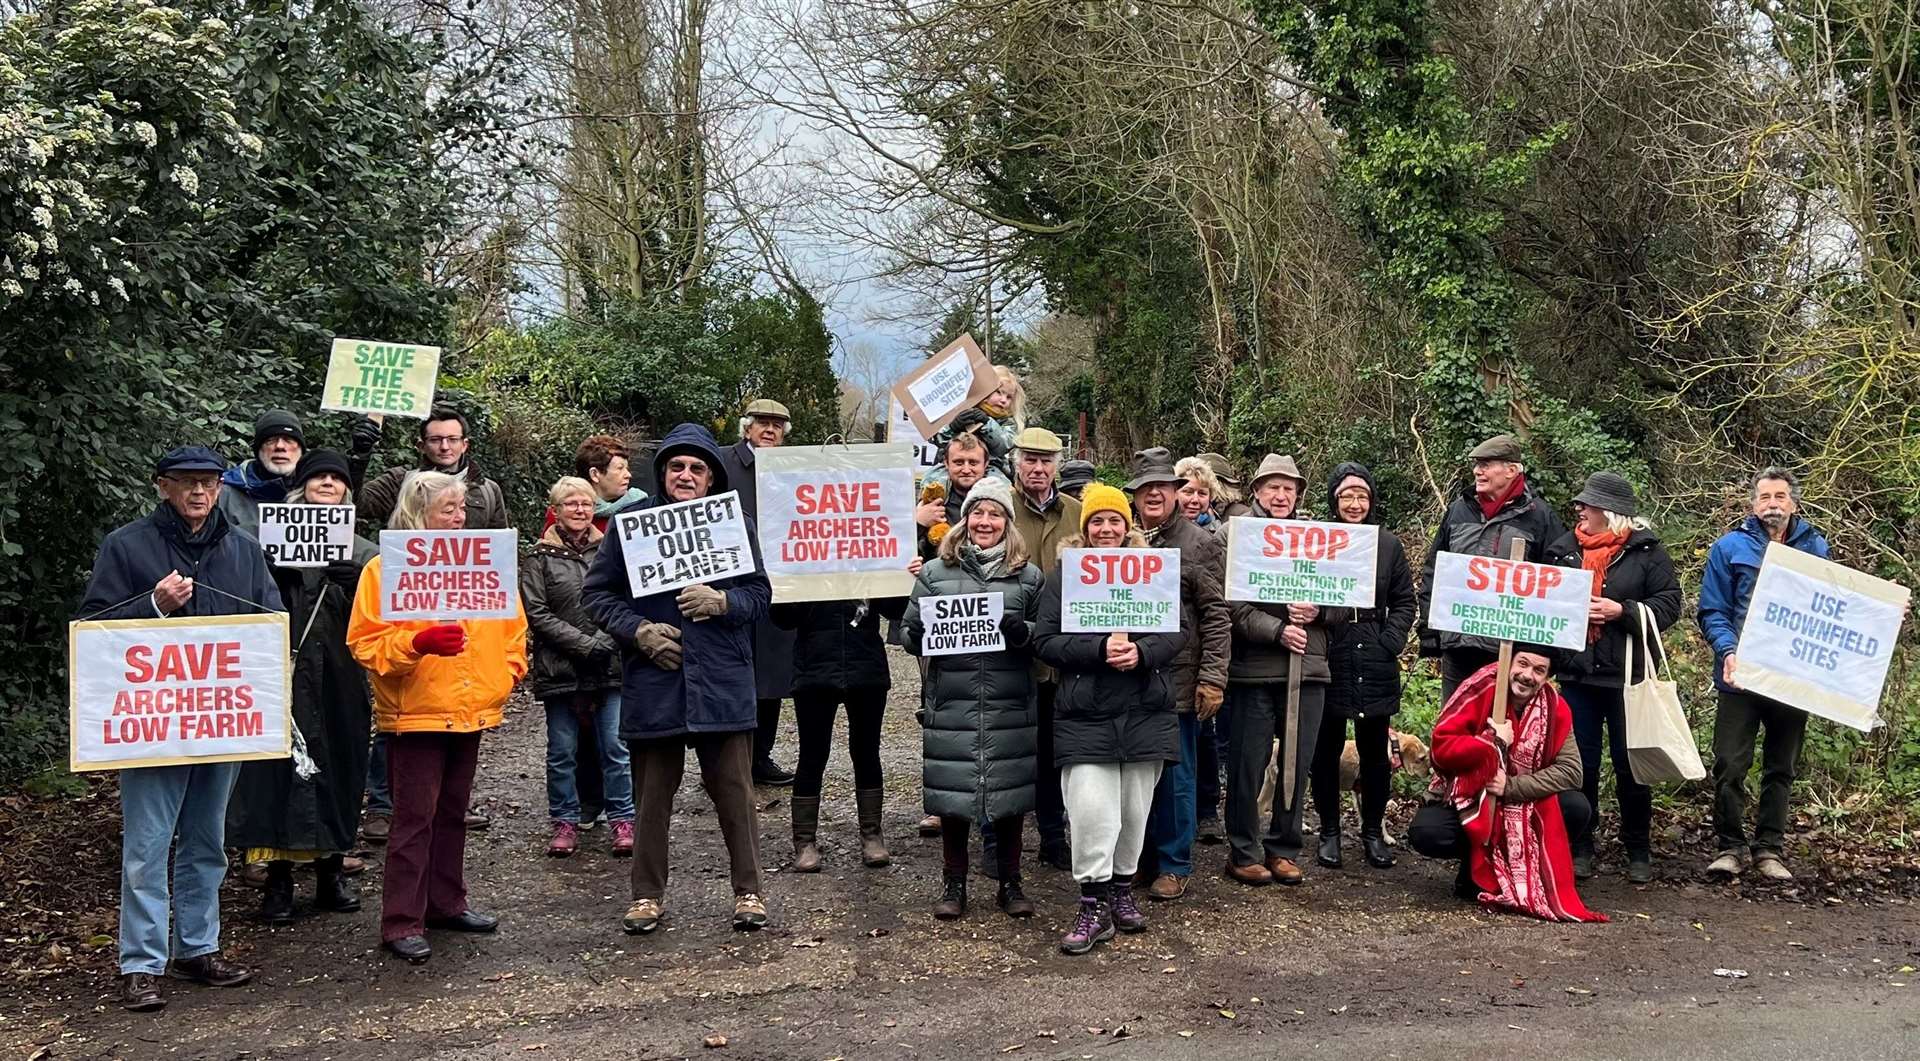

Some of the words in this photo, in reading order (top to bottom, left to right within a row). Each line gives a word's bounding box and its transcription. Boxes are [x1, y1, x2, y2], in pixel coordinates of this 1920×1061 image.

[354, 344, 416, 368] SAVE
[360, 366, 404, 389] THE
[931, 368, 950, 385] USE
[341, 386, 415, 411] TREES
[940, 385, 966, 406] SITES
[796, 482, 880, 515] SAVE
[262, 506, 353, 524] PROTECT
[622, 496, 735, 540] PROTECT
[285, 525, 328, 543] OUR
[788, 516, 890, 540] ARCHERS
[266, 544, 347, 562] PLANET
[406, 537, 491, 566] SAVE
[658, 527, 714, 558] OUR
[782, 541, 830, 562] LOW
[837, 537, 898, 560] FARM
[1263, 524, 1349, 560] STOP
[639, 545, 740, 588] PLANET
[1080, 554, 1163, 585] STOP
[1292, 560, 1317, 573] THE
[1466, 557, 1562, 599] STOP
[398, 571, 500, 590] ARCHERS
[1249, 572, 1337, 590] DESTRUCTION
[1341, 577, 1357, 591] OF
[391, 592, 439, 612] LOW
[446, 591, 507, 611] FARM
[1109, 589, 1133, 600] THE
[1258, 587, 1345, 604] GREENFIELDS
[1498, 595, 1525, 610] THE
[1811, 592, 1847, 621] USE
[936, 597, 989, 619] SAVE
[1070, 601, 1153, 614] DESTRUCTION
[1157, 601, 1173, 614] OF
[1452, 603, 1546, 628] DESTRUCTION
[1551, 617, 1569, 631] OF
[931, 619, 995, 636] ARCHERS
[1080, 615, 1162, 627] GREENFIELDS
[1461, 619, 1554, 644] GREENFIELDS
[1764, 602, 1879, 657] BROWNFIELD
[927, 635, 957, 650] LOW
[962, 632, 1000, 648] FARM
[125, 642, 242, 683] SAVE
[1789, 637, 1840, 671] SITES
[112, 684, 253, 716] ARCHERS
[103, 717, 170, 744] LOW
[180, 712, 263, 740] FARM
